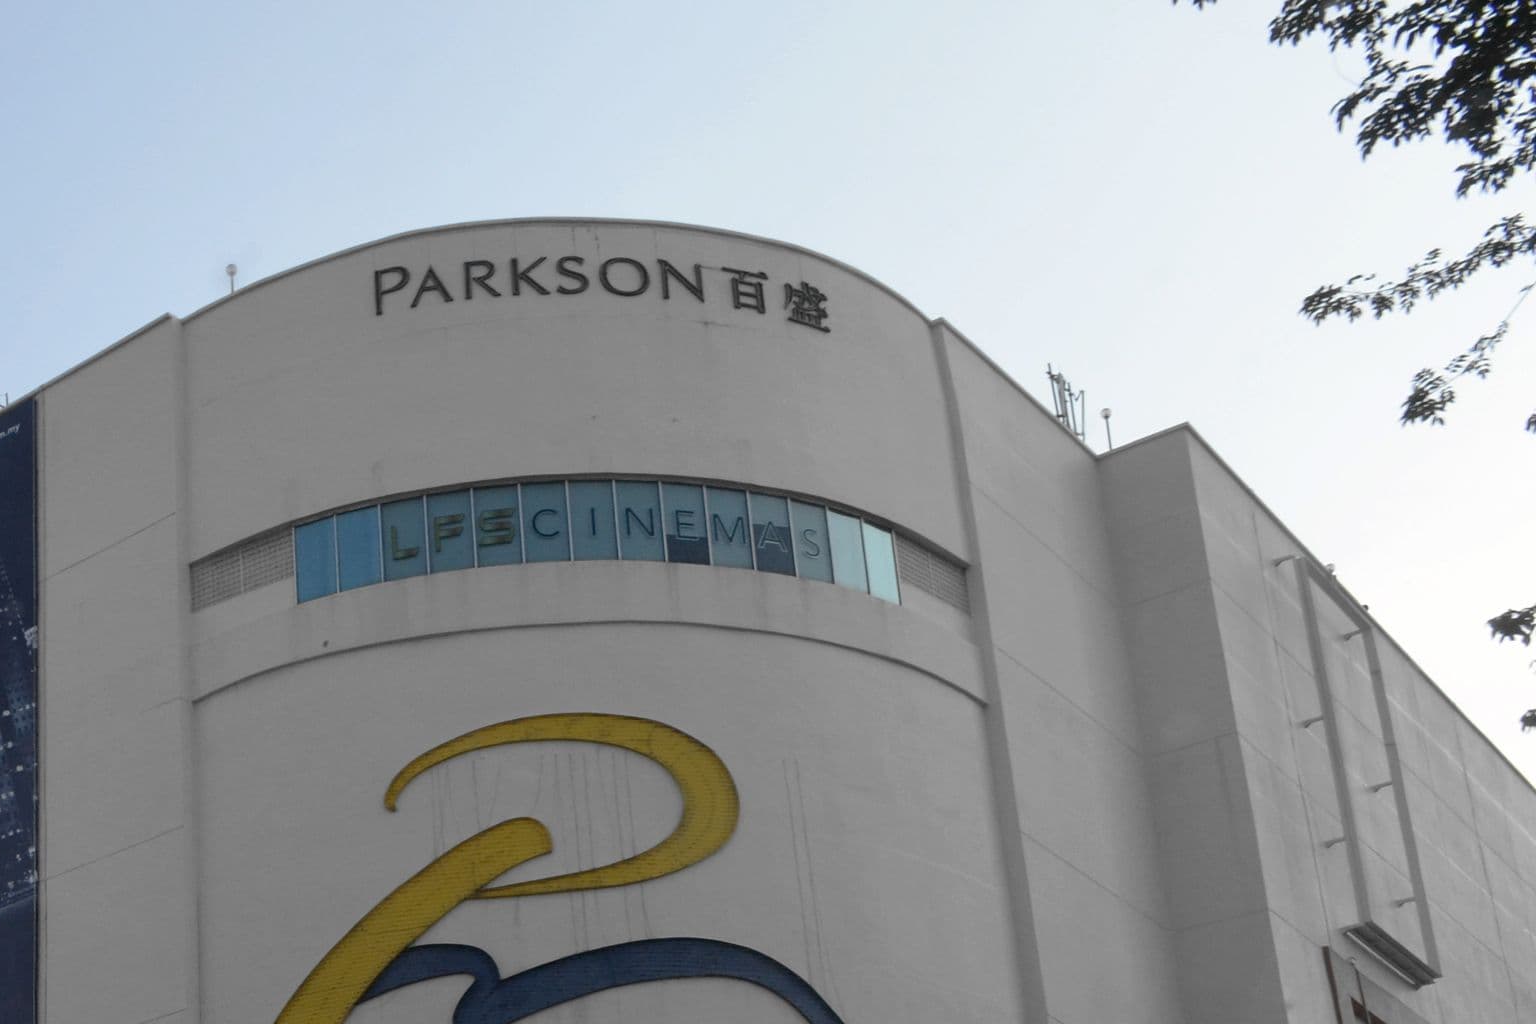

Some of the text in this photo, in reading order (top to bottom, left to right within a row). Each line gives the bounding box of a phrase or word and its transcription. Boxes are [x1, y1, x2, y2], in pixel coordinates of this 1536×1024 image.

[373, 256, 705, 315] PARKSON
[721, 266, 831, 333] 百盛
[390, 506, 821, 561] LFS CINEMAS
